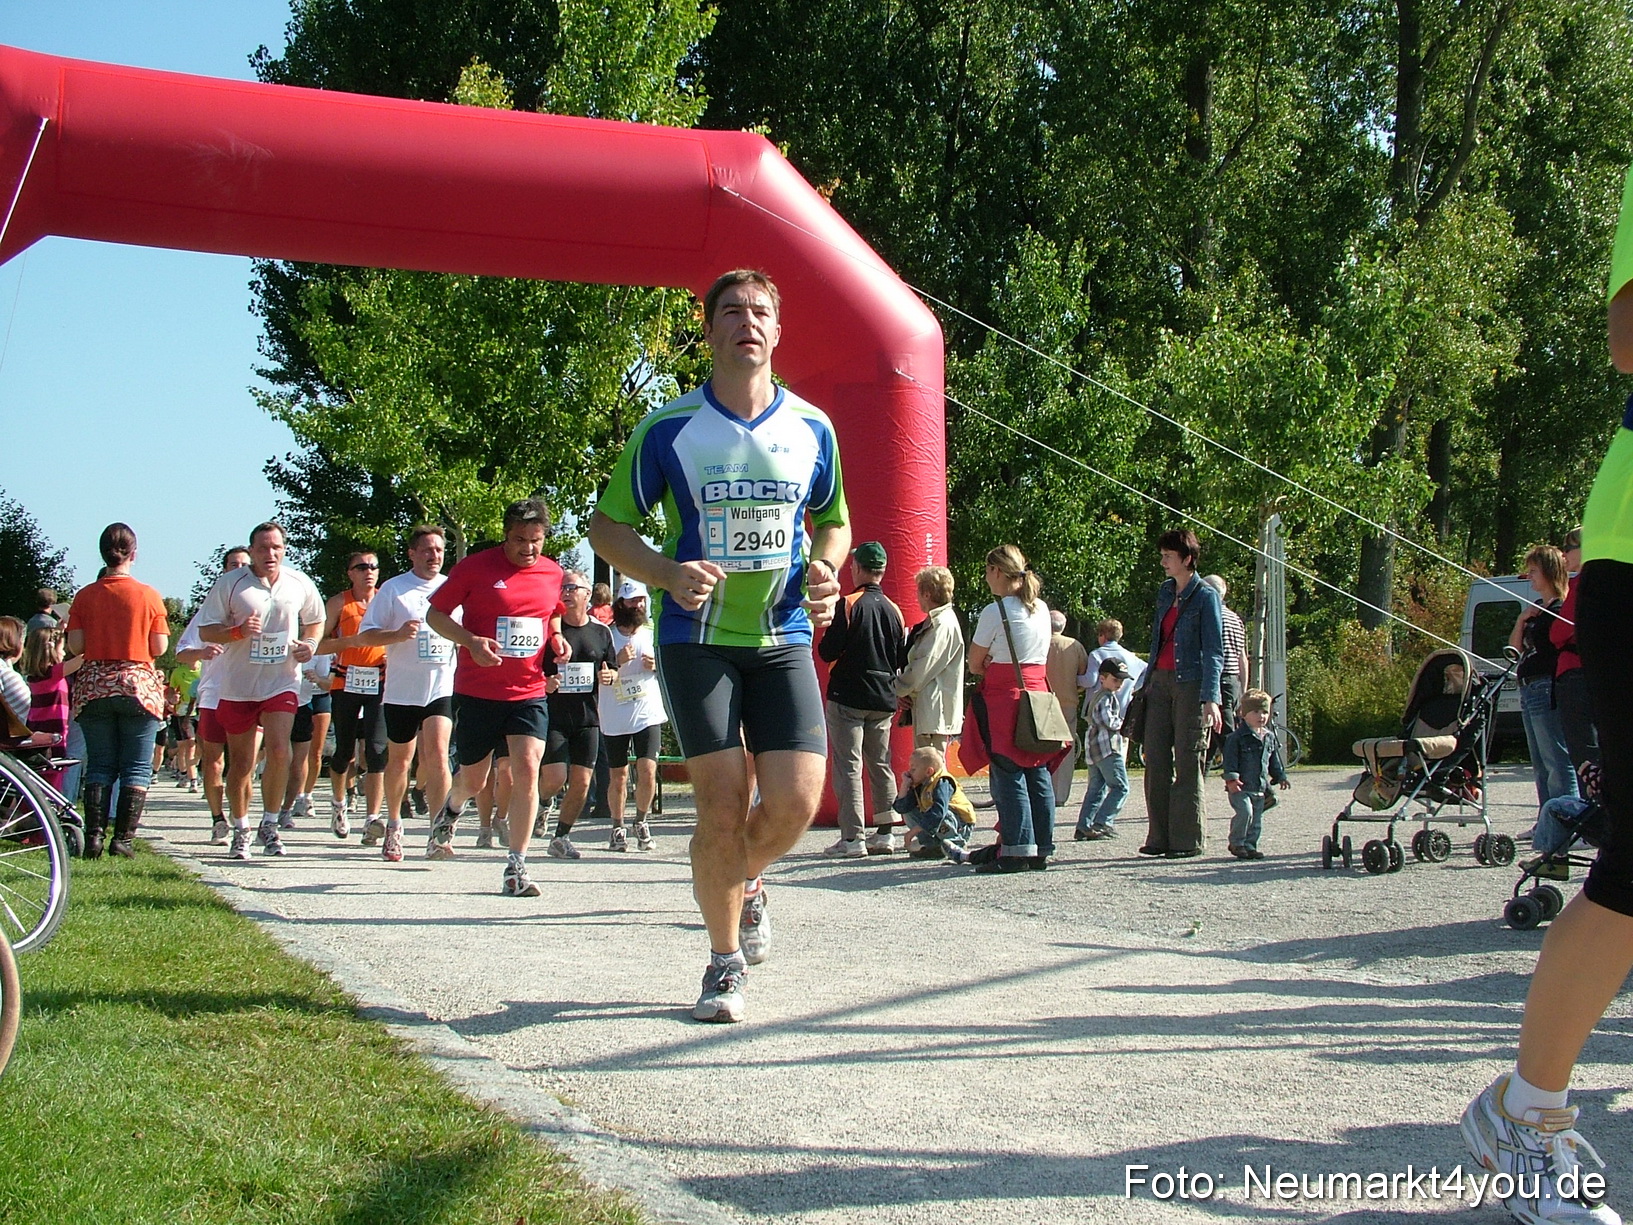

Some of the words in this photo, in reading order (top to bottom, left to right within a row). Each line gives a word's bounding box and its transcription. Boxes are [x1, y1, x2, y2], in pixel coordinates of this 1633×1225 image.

[704, 463, 749, 475] TEAM
[701, 479, 800, 503] BOCK
[731, 507, 780, 522] Wolfgang
[733, 529, 786, 552] 2940
[510, 635, 539, 646] 2282
[262, 645, 286, 656] 3139
[354, 678, 376, 687] 3115
[568, 675, 592, 685] 3138
[626, 684, 642, 695] 138
